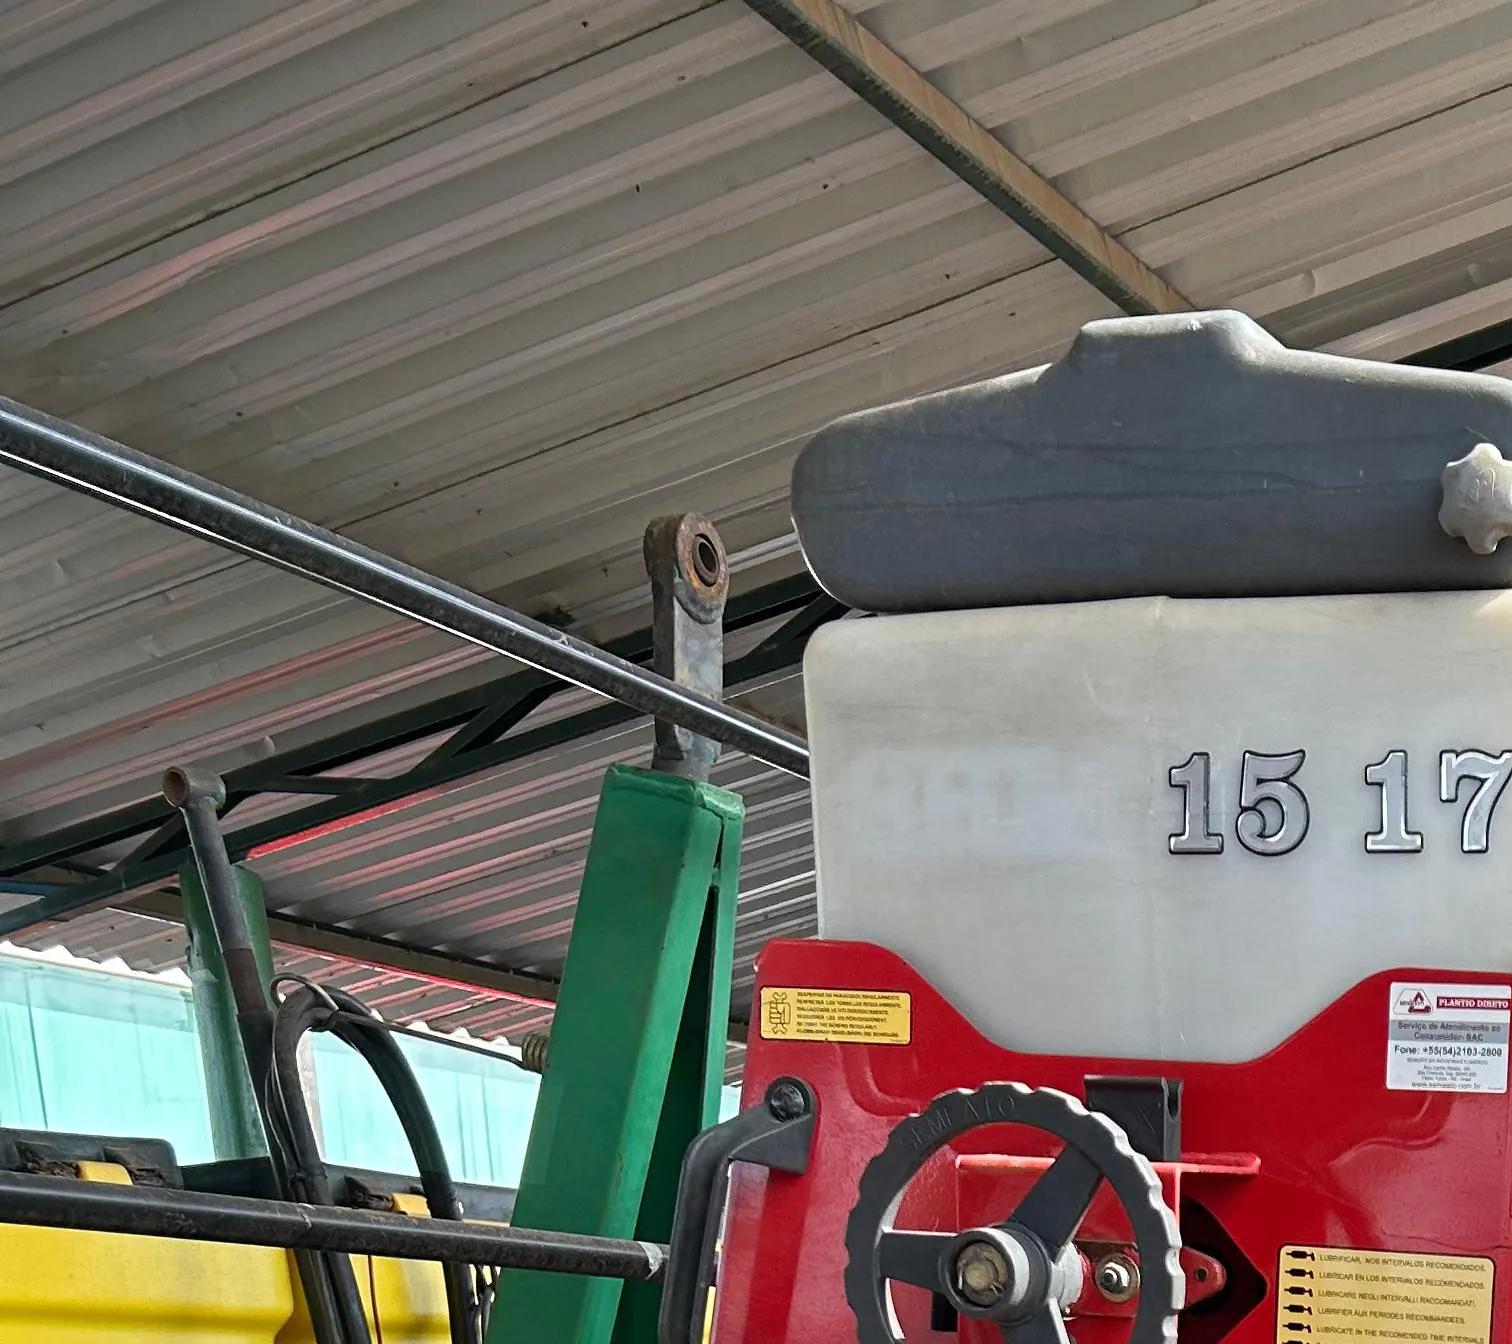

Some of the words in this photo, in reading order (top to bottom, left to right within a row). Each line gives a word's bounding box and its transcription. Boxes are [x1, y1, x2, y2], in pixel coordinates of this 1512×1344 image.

[1168, 750, 1310, 857] 15
[1438, 998, 1475, 1007] PLANTIO
[1477, 999, 1508, 1008] DIRETO
[1398, 1021, 1426, 1030] Serviço
